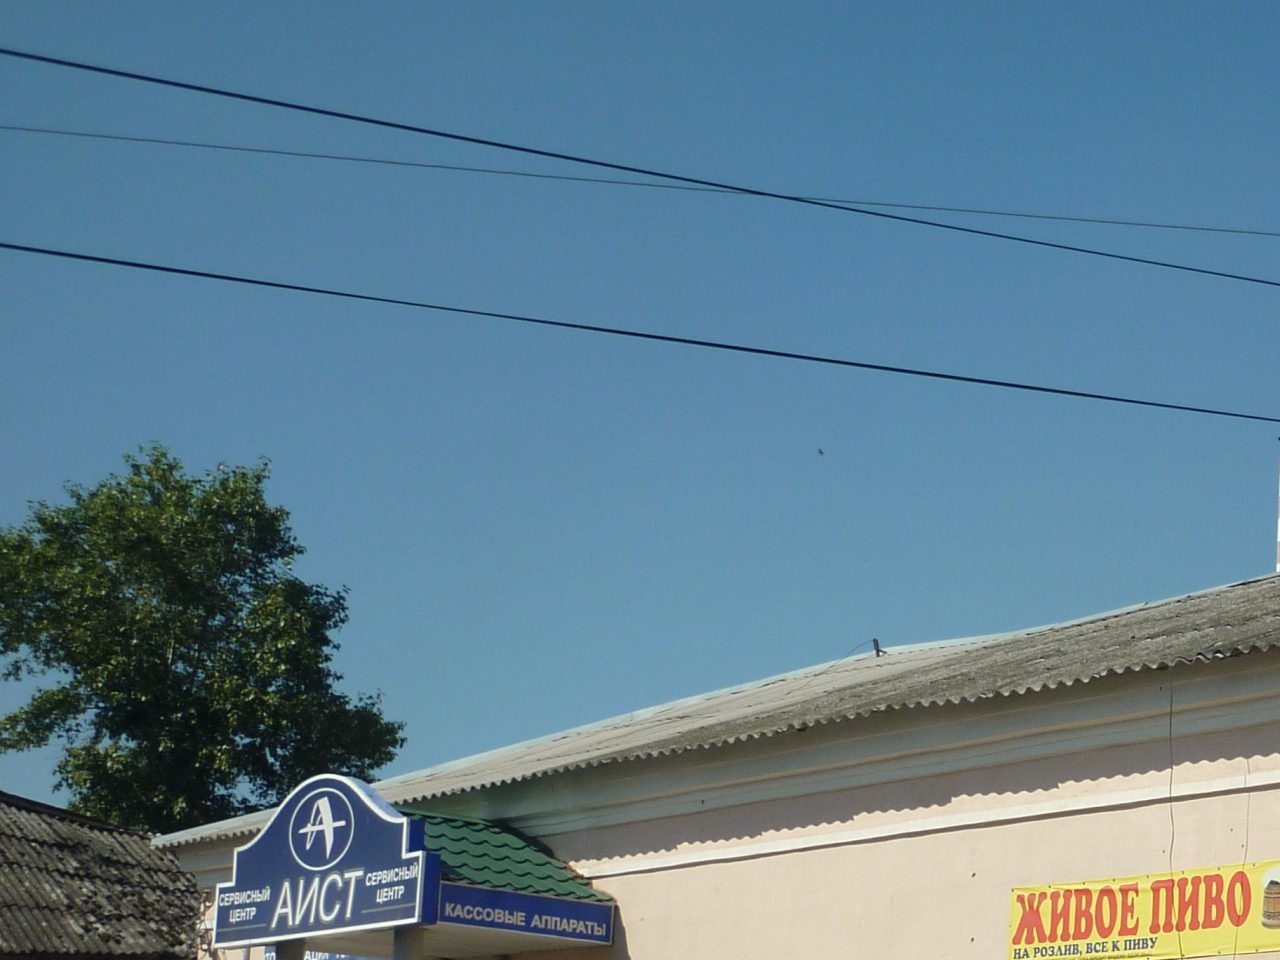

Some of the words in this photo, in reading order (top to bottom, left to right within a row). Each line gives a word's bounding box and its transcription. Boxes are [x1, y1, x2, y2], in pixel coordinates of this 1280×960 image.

[365, 862, 419, 886] СЕРВИСНЫЙ
[219, 886, 271, 906] СЕРВИСНЫЙ
[269, 868, 365, 931] АИСТ
[376, 885, 405, 904] ЦЕНТР
[229, 907, 257, 923] ЦЕНТР
[445, 902, 526, 926] КАССОВЫЕ
[530, 914, 606, 936] АППАРАТЫ
[1012, 882, 1140, 945] ЖИВОЕ
[1149, 870, 1252, 934] ПИВО
[1013, 947, 1030, 959] НА
[1033, 943, 1083, 958] РОЗЛИВ,
[1086, 941, 1109, 954] ВСЕ
[1112, 940, 1121, 952] К
[1124, 937, 1159, 951] ПИВУ
